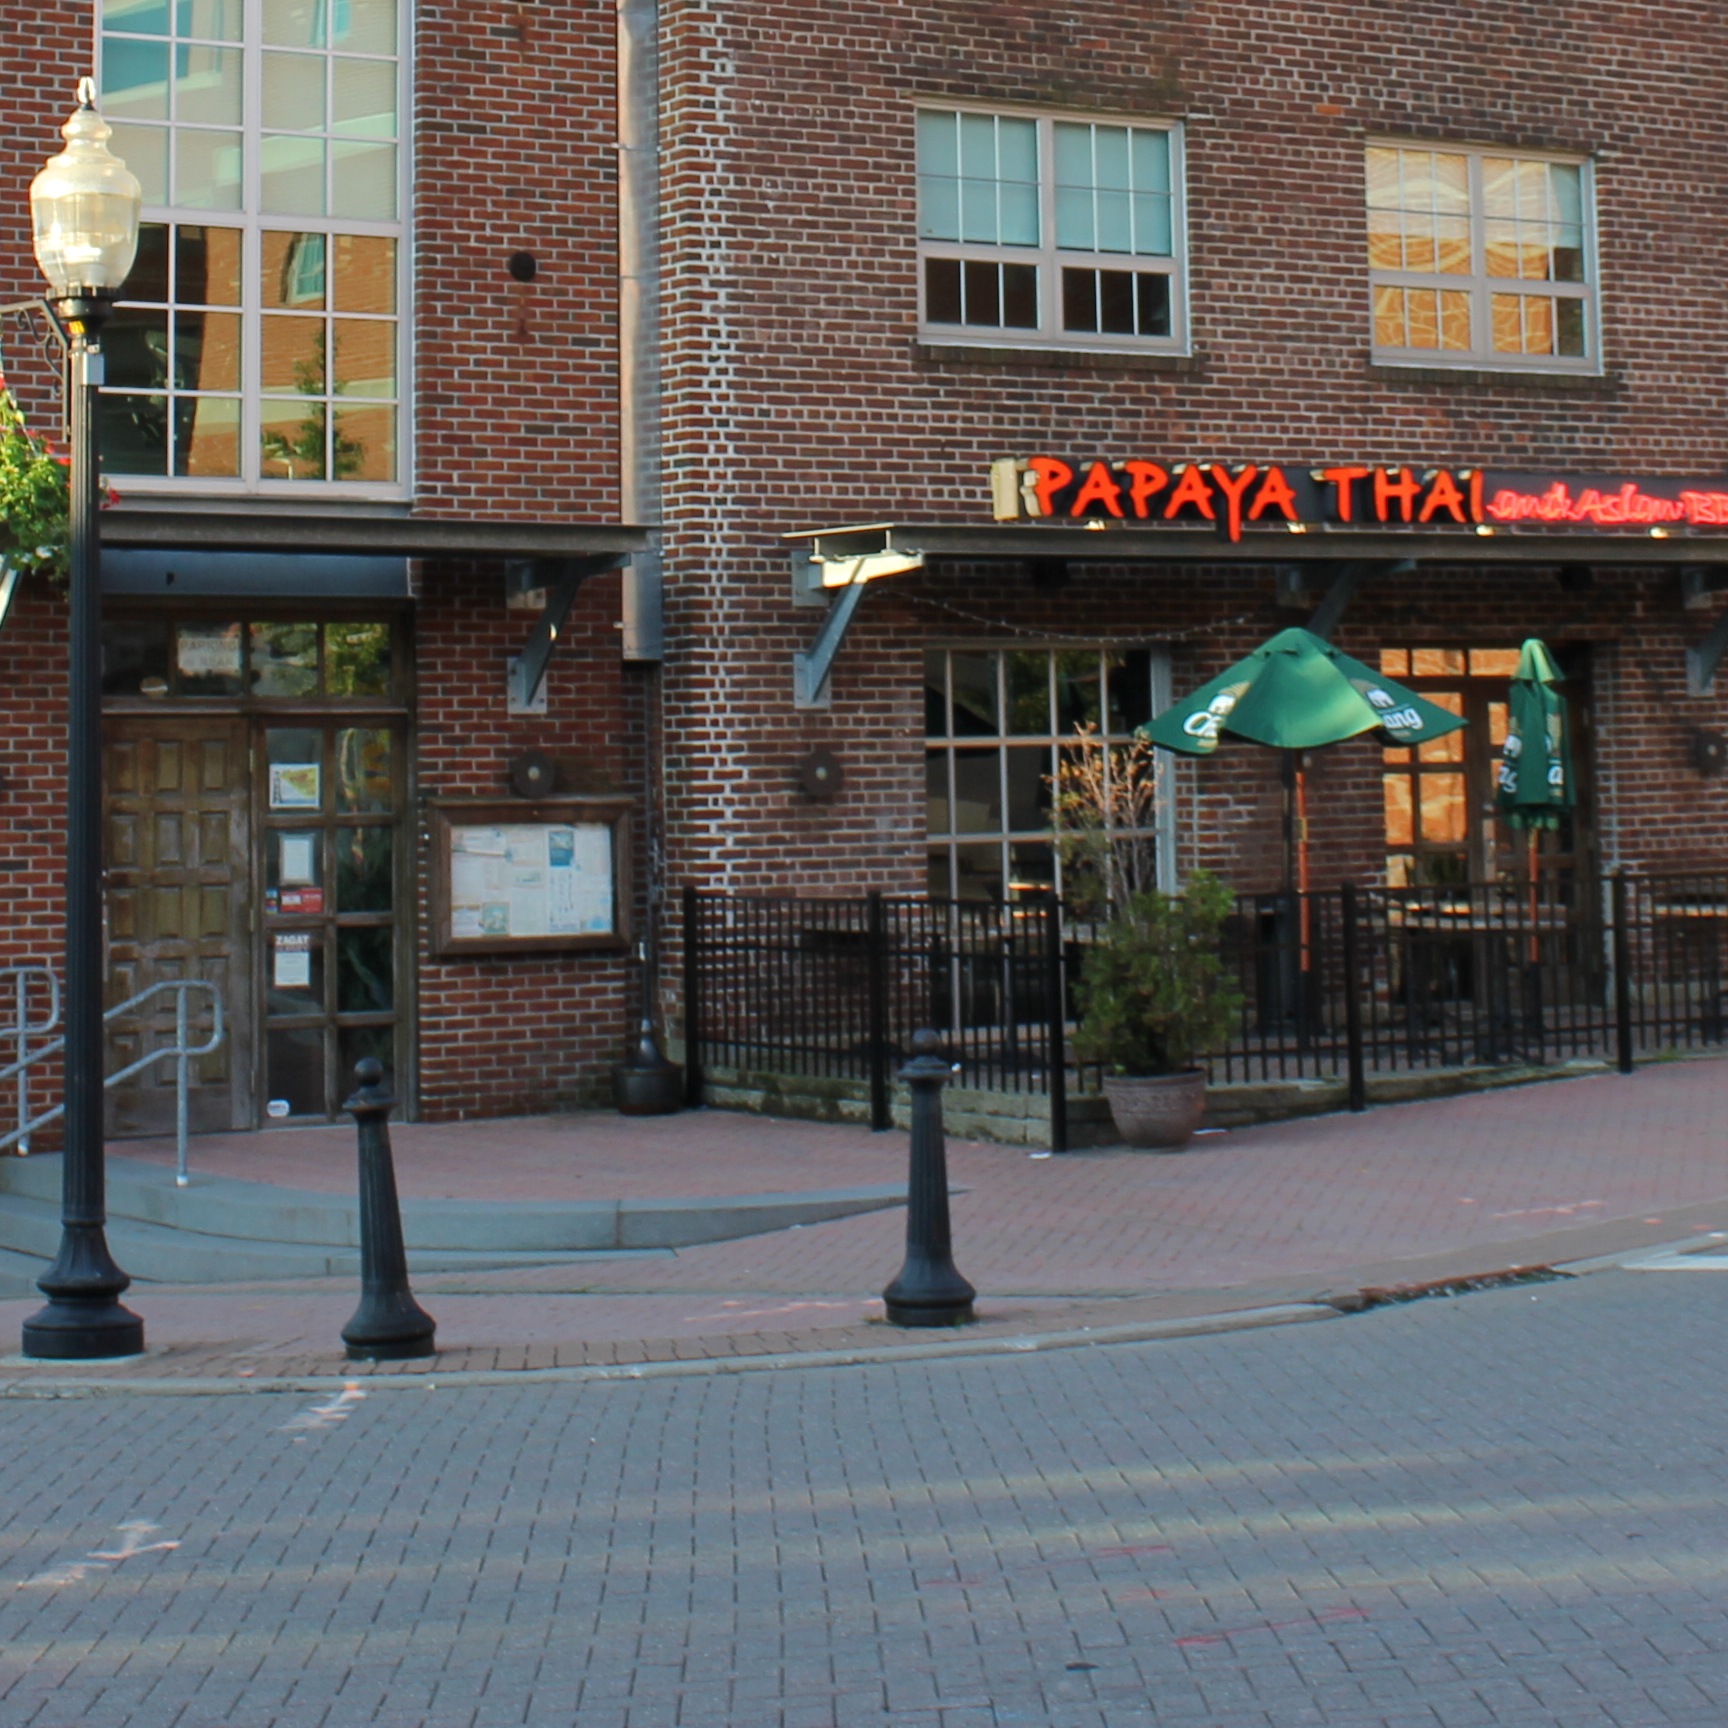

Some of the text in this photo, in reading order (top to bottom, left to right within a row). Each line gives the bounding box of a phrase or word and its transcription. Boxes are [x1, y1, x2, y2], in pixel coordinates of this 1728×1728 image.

[1029, 457, 1482, 542] PAPAYA THAI
[1486, 481, 1570, 520] and
[1569, 482, 1684, 524] Asian
[276, 934, 309, 945] ZAGAT
